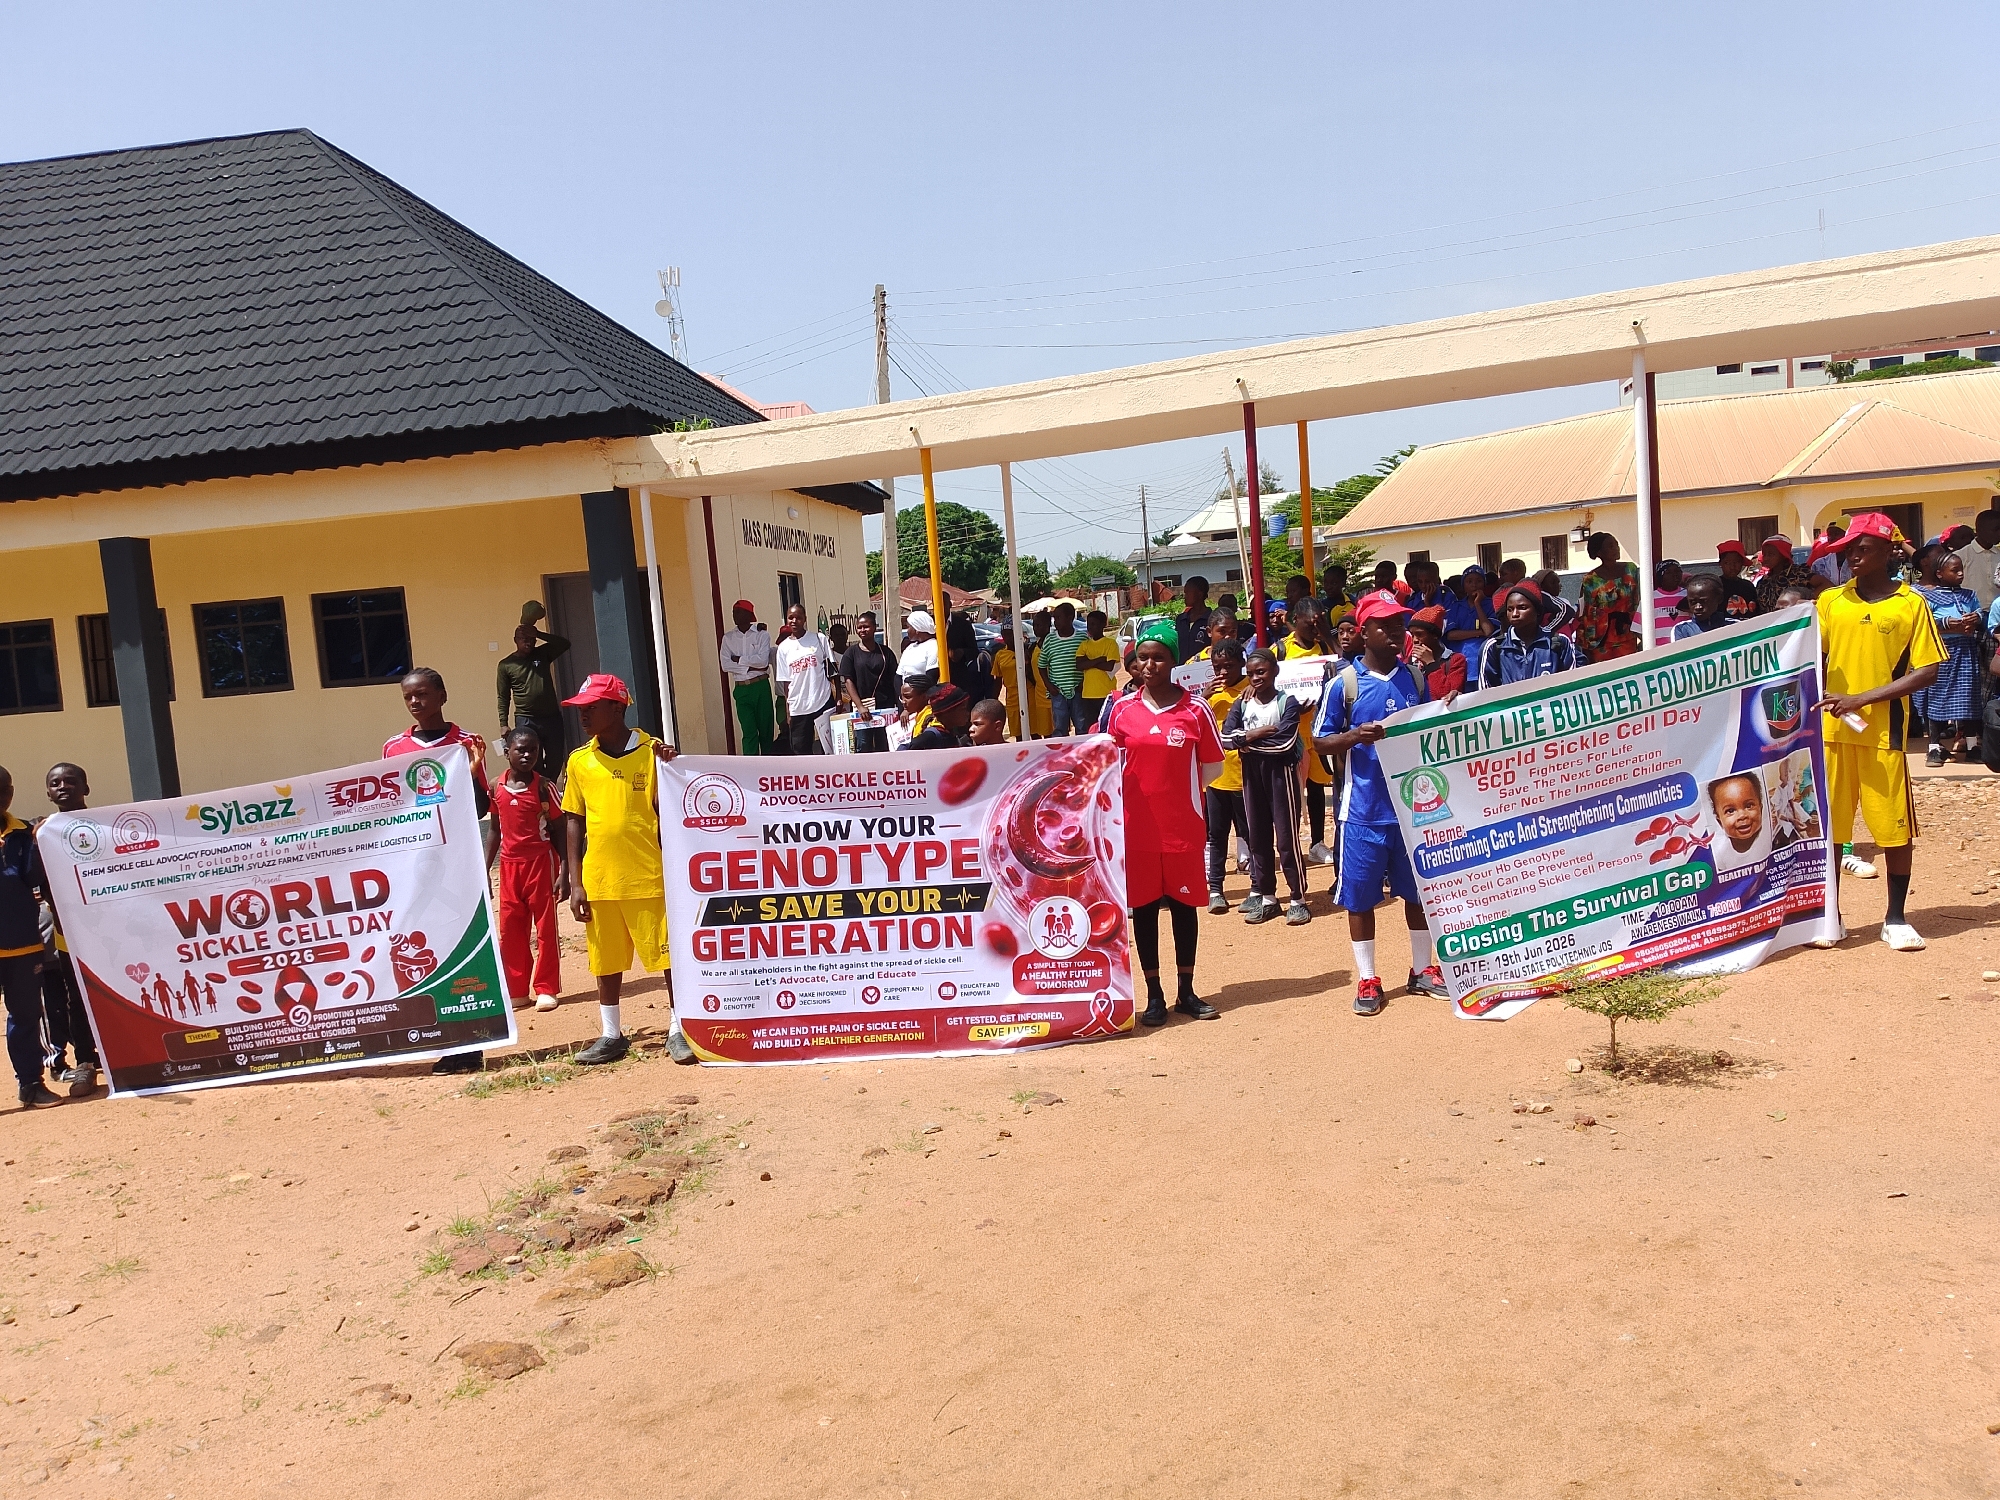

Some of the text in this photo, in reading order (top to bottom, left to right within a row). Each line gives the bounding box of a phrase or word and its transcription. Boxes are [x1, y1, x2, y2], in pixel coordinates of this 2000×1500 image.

[742, 518, 836, 558] MASS COMMUNICATION COMPLEX
[1420, 640, 1780, 764] KATHY LIFE BUILDER FOUNDATION
[1467, 706, 1701, 778] World Sickle Cell Day
[758, 769, 926, 793] SHEM SICKLE CELL
[1477, 744, 1633, 792] SCD Fighters For Life
[1499, 750, 1662, 798] Save The Next Generation
[760, 789, 927, 806] ADVOCACY FOUNDATION
[1484, 758, 1682, 817] Sufer Not The Innocent Children
[200, 797, 296, 835] Sylazz
[762, 816, 935, 845] KNOW YOUR
[1418, 782, 1683, 871] Transforming Care And Strengthening Communities
[82, 810, 431, 877] SHEM SICKLE CELL ADVOCACY FOUNDATION LIFE BUILDER FOUNDATION
[1423, 825, 1466, 848] Theme:
[91, 884, 128, 896] PLATEAU
[131, 879, 155, 890] STATE
[157, 872, 197, 886] MINISTRY
[212, 864, 244, 876] HEALTH
[278, 855, 304, 865] FARMZ
[307, 847, 346, 860] VENTURES
[356, 841, 379, 851] PRIME
[380, 836, 416, 848] LOGISTICS
[418, 833, 431, 842] LTD
[197, 846, 290, 869] Collaboration
[688, 838, 982, 891] GENOTYPE
[1465, 848, 1566, 883] Your Hb Genotype
[1467, 852, 1643, 909] Stigmatizing Sickle Cell Persons
[1472, 853, 1593, 894] Cell Can Be Prevented
[164, 869, 390, 940] WORLD
[760, 888, 942, 921] SAVE YOUR
[1445, 868, 1706, 956] Closing The Survival Gap
[1654, 894, 1698, 918] 10:00AM
[1443, 909, 1510, 934] Global Theme:
[1631, 915, 1677, 941] AWARENESS
[177, 911, 393, 963] SICKLE CELL DAY
[692, 915, 973, 961] GENERATION
[263, 950, 315, 969] 2026
[741, 966, 792, 975] stakeholders
[819, 963, 837, 972] fight
[840, 962, 868, 974] against
[886, 959, 911, 969] spread
[1453, 934, 1576, 978] DATE: 19th Jun 2026
[1455, 976, 1480, 994] VENUE:
[1482, 965, 1521, 982] PLATEAU
[1523, 961, 1544, 977] STATE
[1546, 945, 1597, 971] POLYTECHNIC
[1598, 940, 1613, 954] JOS
[755, 978, 776, 986] Let's
[780, 976, 829, 984] Advocate,
[857, 972, 874, 980] and
[878, 970, 916, 979] Educate
[1029, 969, 1102, 980] HEALTHY FUTURE
[1035, 980, 1088, 989] TOMORROW
[441, 1000, 495, 1014] UPDATE TV.
[460, 995, 475, 1004] AG
[225, 1004, 399, 1035] BUILDING HOPE. PROMOTING AWARENESS,
[228, 1015, 386, 1043] AND STRENGTHENING SUPPORT FOR PERSON
[752, 1021, 920, 1037] WE CAN END THE PAIN OF SICKLE CELL
[970, 1016, 998, 1024] TESTED,
[1018, 1012, 1064, 1021] INFORMED,
[977, 1027, 1004, 1037] SAVE
[229, 1027, 356, 1051] LIVING WITH SICKLE CELL DISORDER
[708, 1026, 749, 1046] Together,
[753, 1032, 924, 1049] AND BUILD HEALTHIER GENERATION!
